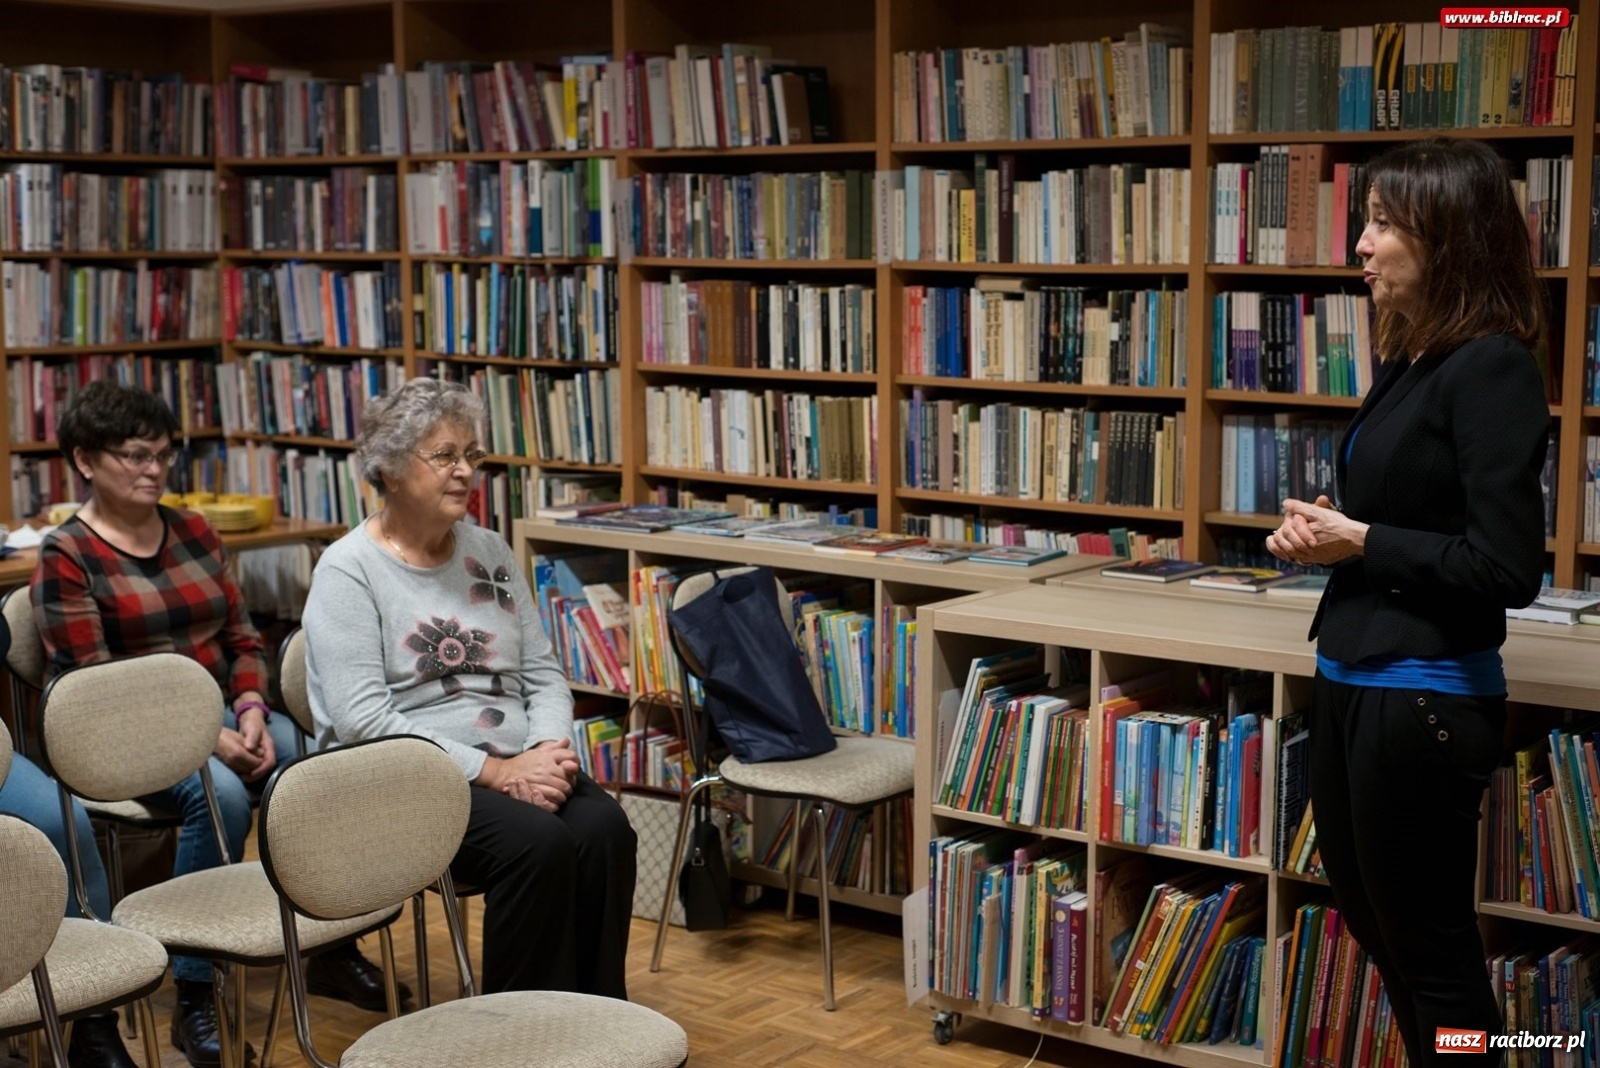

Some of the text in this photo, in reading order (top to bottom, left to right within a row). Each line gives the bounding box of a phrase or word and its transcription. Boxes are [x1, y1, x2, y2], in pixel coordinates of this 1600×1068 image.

[1376, 89, 1386, 128] CHŁOPI
[1390, 89, 1400, 128] CHŁOPI
[1482, 114, 1490, 123] 2
[1494, 114, 1502, 123] 2
[1056, 934, 1064, 958] MINUT
